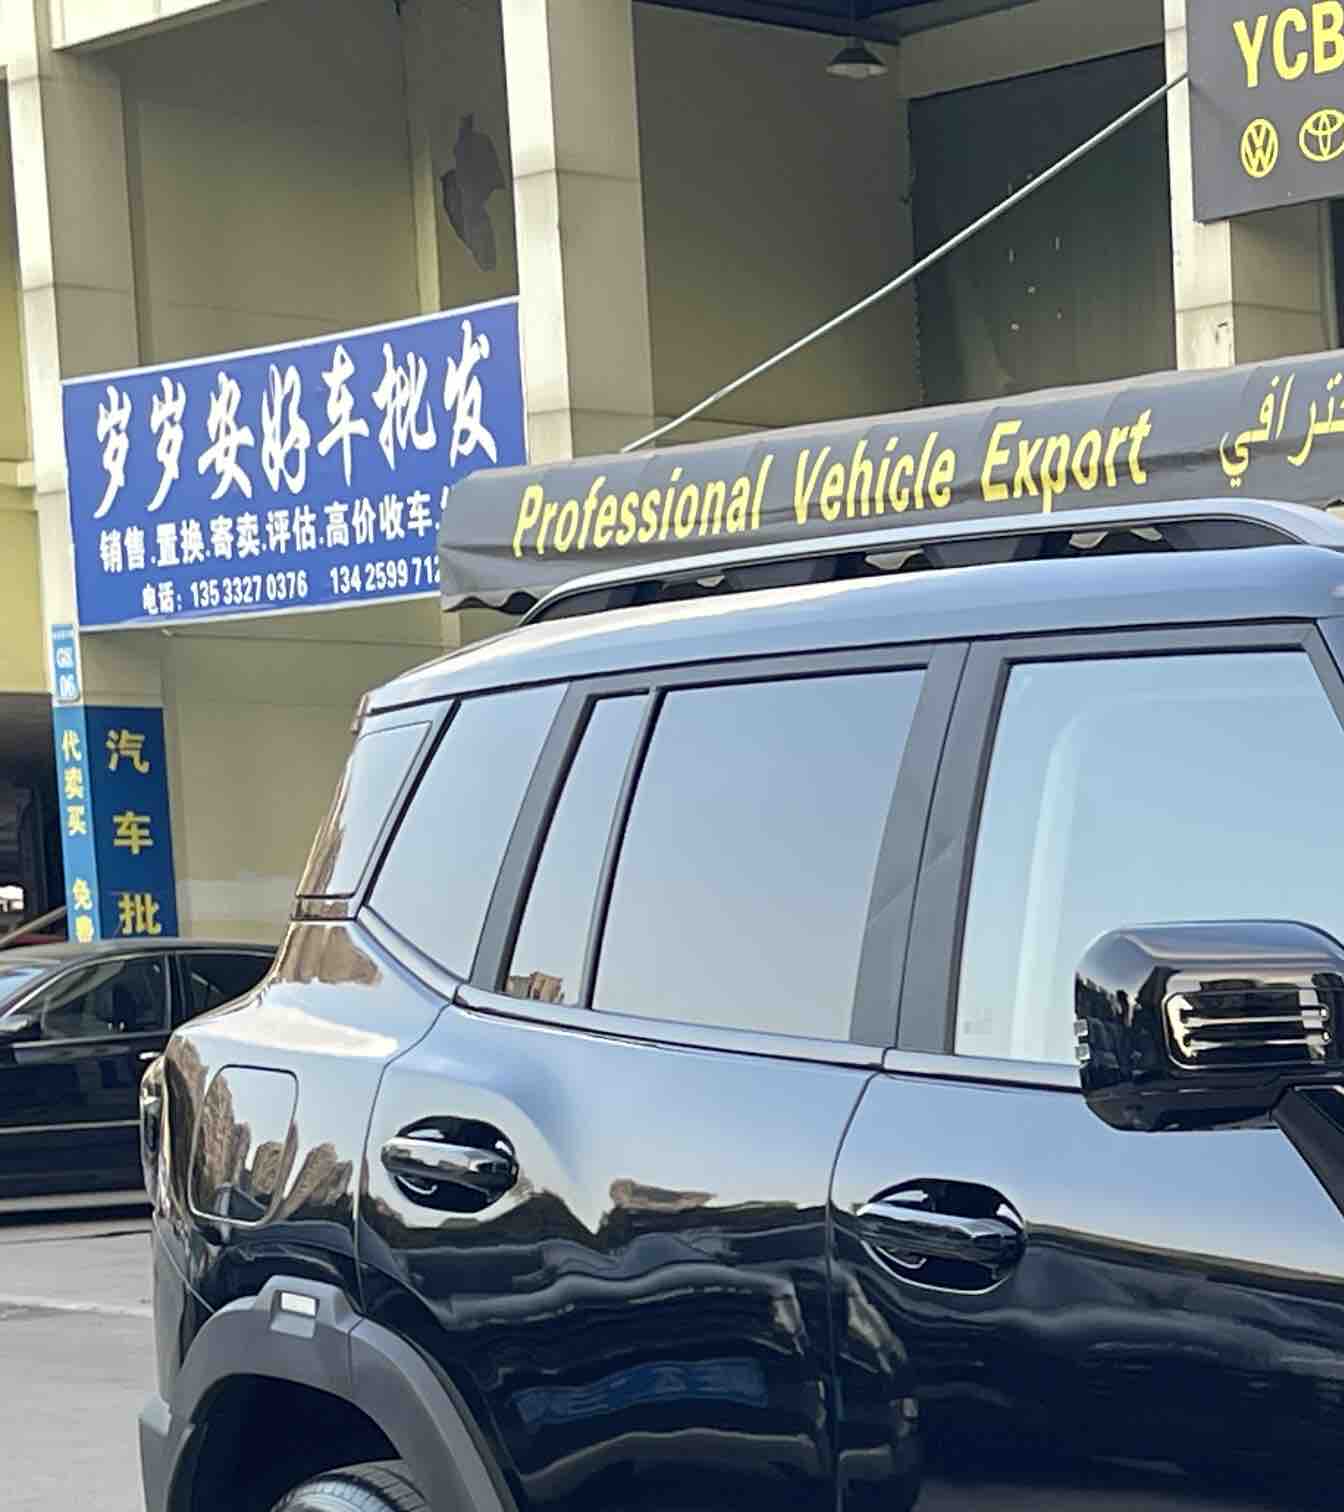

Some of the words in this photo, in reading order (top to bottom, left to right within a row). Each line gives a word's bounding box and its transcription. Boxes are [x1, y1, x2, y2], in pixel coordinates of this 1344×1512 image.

[94, 320, 497, 518] 岁岁安好车批发
[100, 487, 452, 573] 销售.置换.寄卖.评估.高价收车.
[513, 455, 772, 558] Professional
[794, 432, 955, 525] Vehicle
[980, 408, 1152, 513] Export
[190, 579, 220, 608] 135
[222, 575, 262, 605] 3327
[266, 569, 308, 602] 0376
[330, 567, 362, 595] 134
[363, 560, 409, 591] 2599
